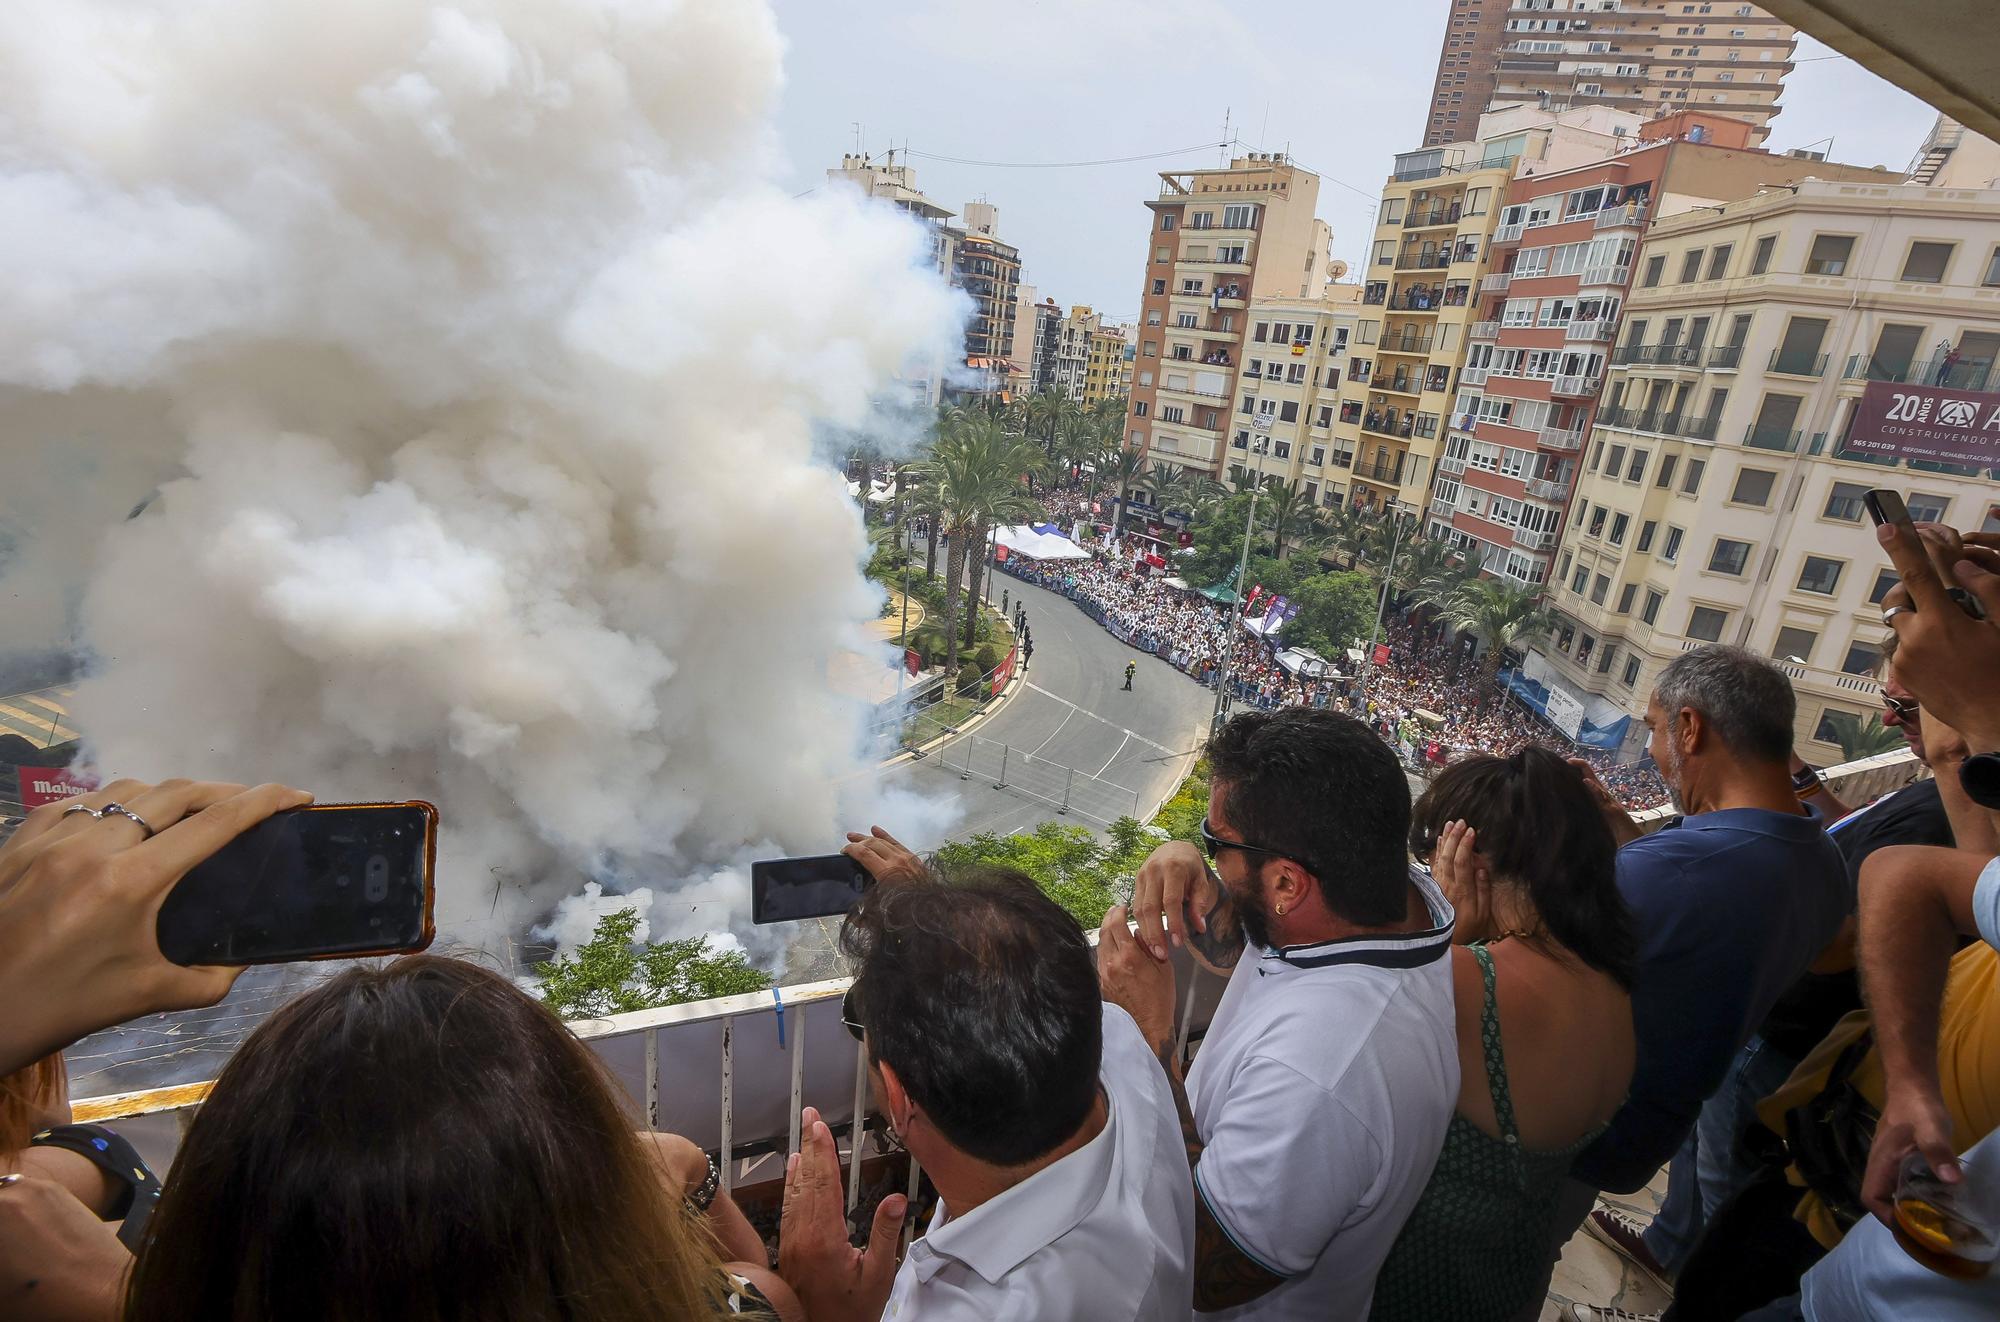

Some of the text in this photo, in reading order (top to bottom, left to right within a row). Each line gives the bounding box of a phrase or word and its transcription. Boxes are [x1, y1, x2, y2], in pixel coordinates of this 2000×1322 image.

[1885, 393, 1921, 422] 20
[1881, 425, 1988, 446] CONSTRUYENDO
[1852, 439, 1896, 451] 965 201 039
[1902, 446, 1937, 456] REFORMAS
[32, 780, 88, 795] Mahou
